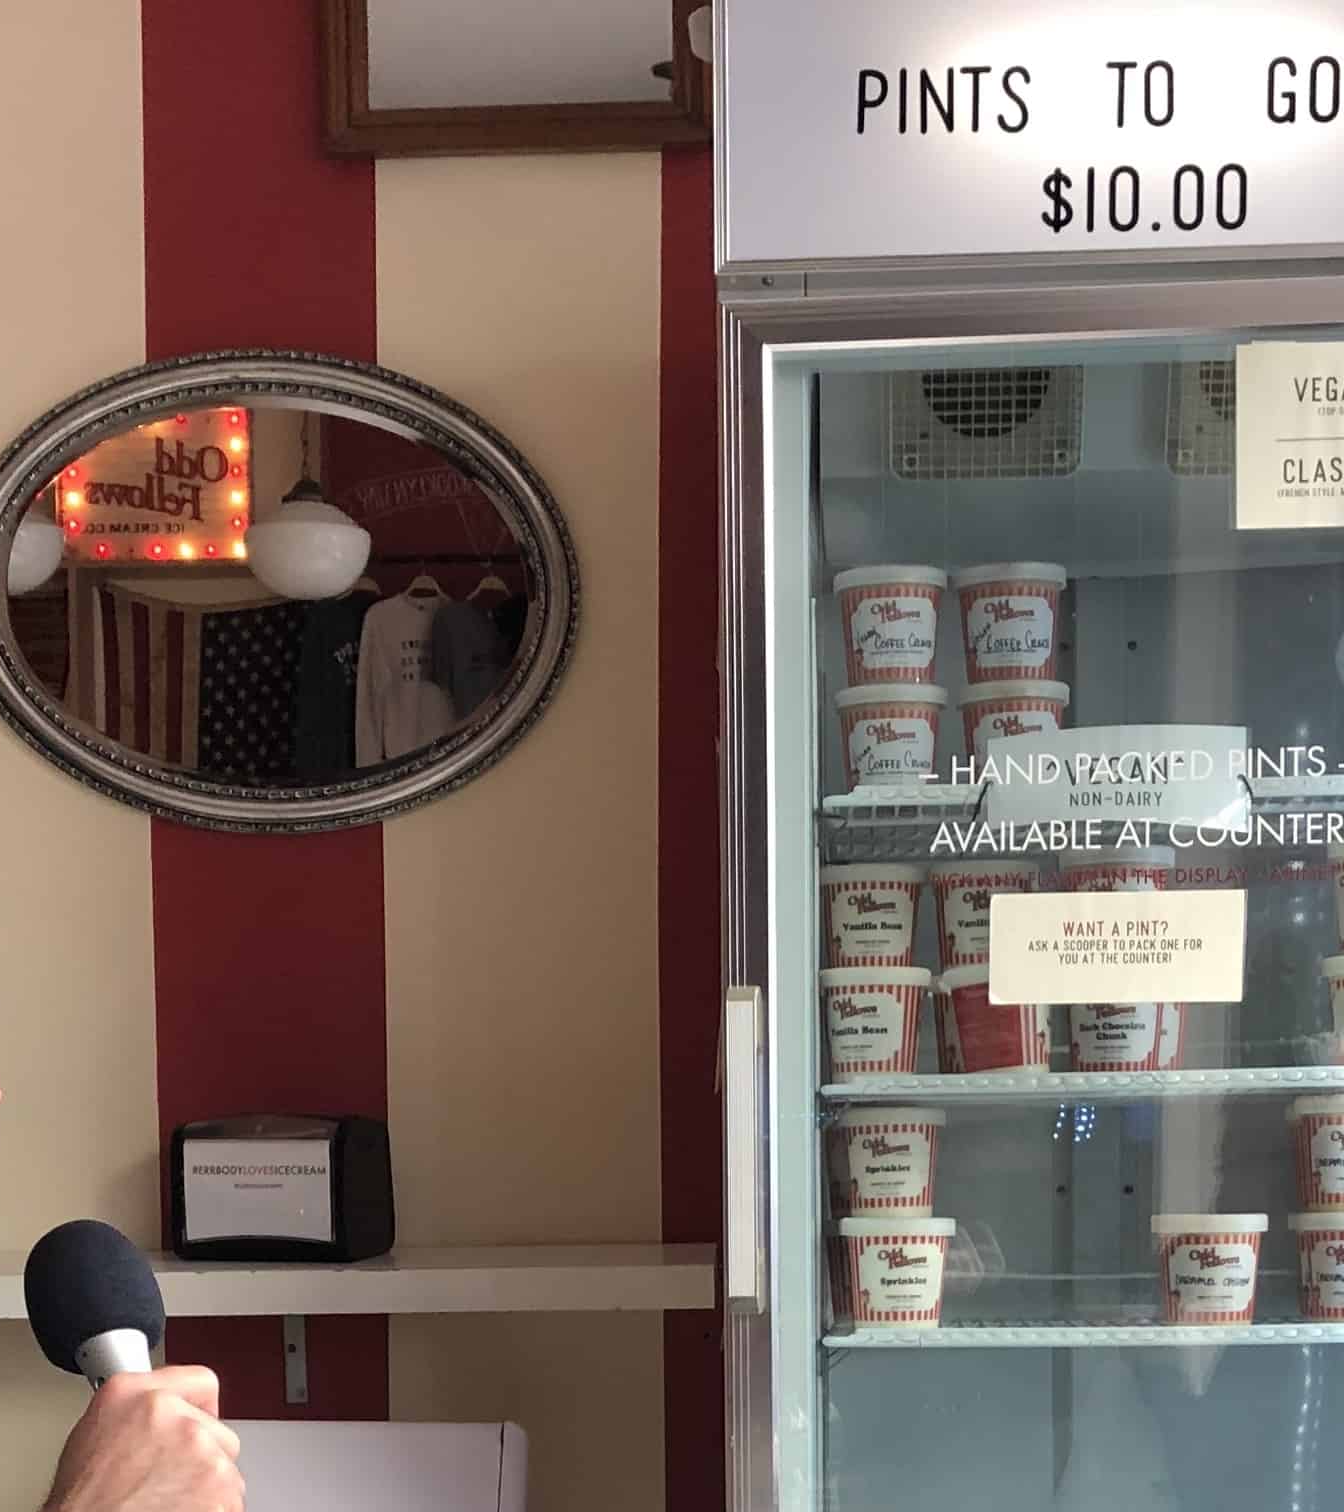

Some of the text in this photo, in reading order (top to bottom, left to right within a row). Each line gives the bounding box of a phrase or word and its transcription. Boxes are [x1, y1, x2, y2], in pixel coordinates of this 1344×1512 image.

[856, 55, 1343, 134] PINTS TO GO
[1041, 163, 1249, 233] $10.00
[951, 753, 1061, 785] HAND
[1075, 751, 1213, 783] PACKED
[1228, 746, 1326, 779] PINTS
[1069, 791, 1163, 807] NON-DAIRY
[930, 812, 1344, 852] AVAILABLE AT COUNTER
[1134, 868, 1169, 885] THE
[1175, 866, 1250, 885] DISPLAY
[1063, 920, 1169, 937] WANT A PINT?
[1028, 938, 1203, 952] ASK A SCOOPER TO PACK ONE FOR
[1058, 953, 1078, 965] YOU
[1082, 953, 1095, 965] AT
[1101, 952, 1119, 964] THE
